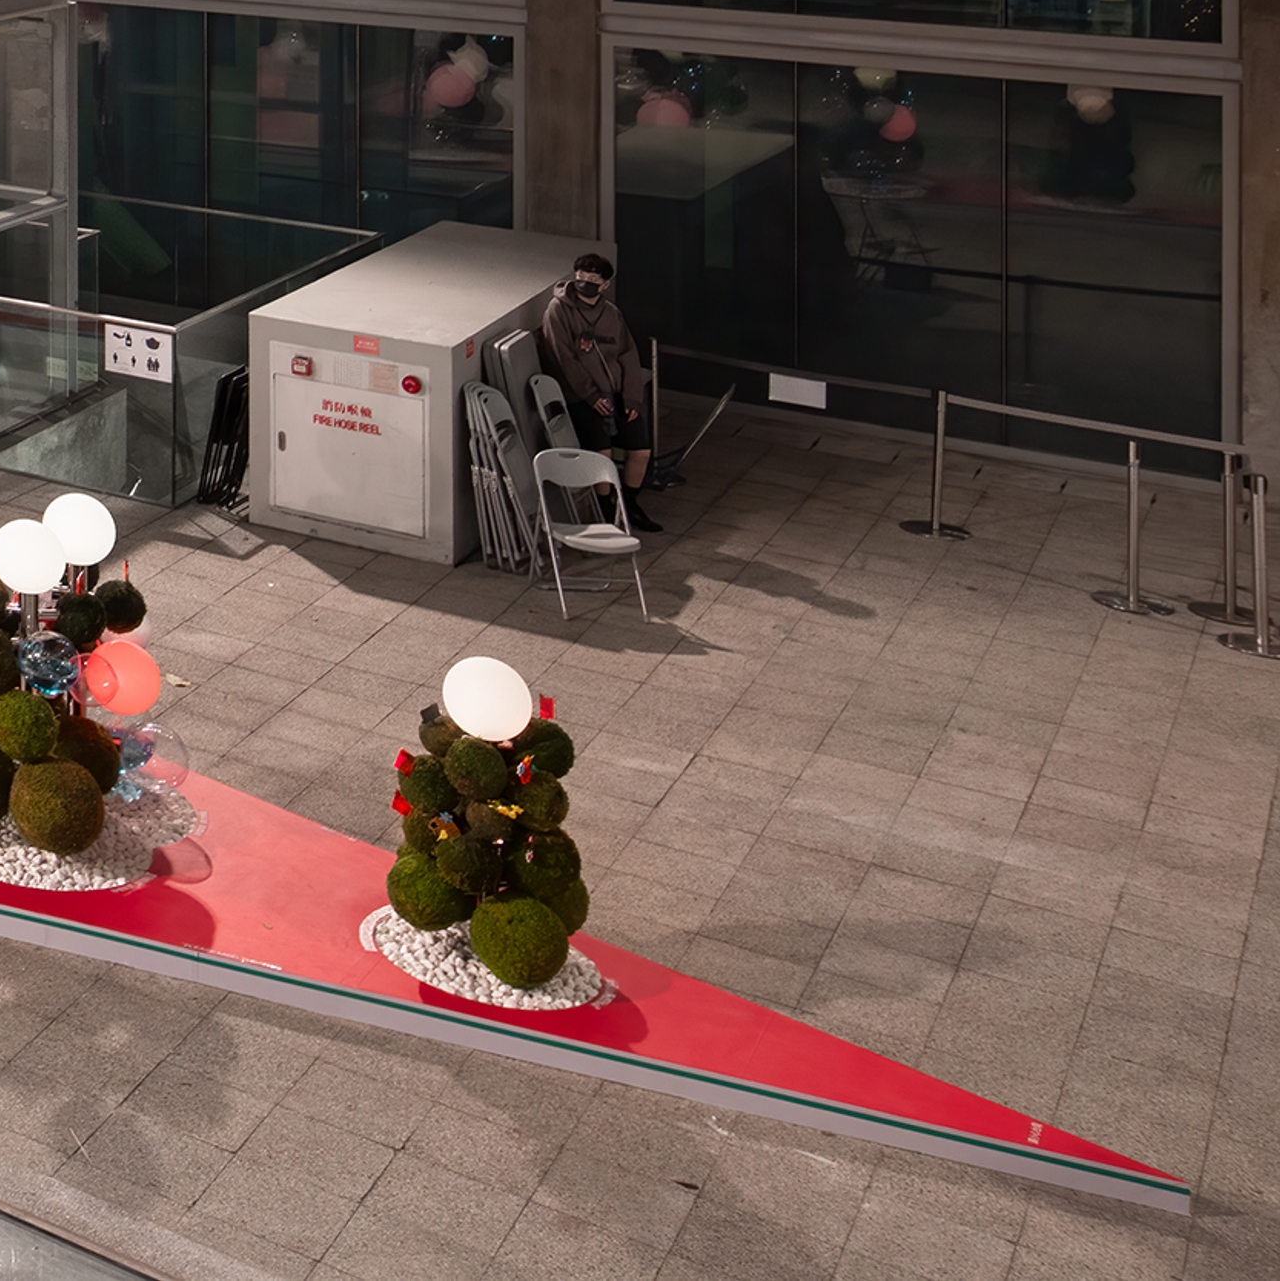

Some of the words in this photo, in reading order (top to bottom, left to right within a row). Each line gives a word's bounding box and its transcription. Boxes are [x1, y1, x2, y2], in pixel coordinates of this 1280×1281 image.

[313, 413, 333, 427] FIRE
[333, 417, 358, 431] HOSE
[358, 421, 382, 436] REEL
